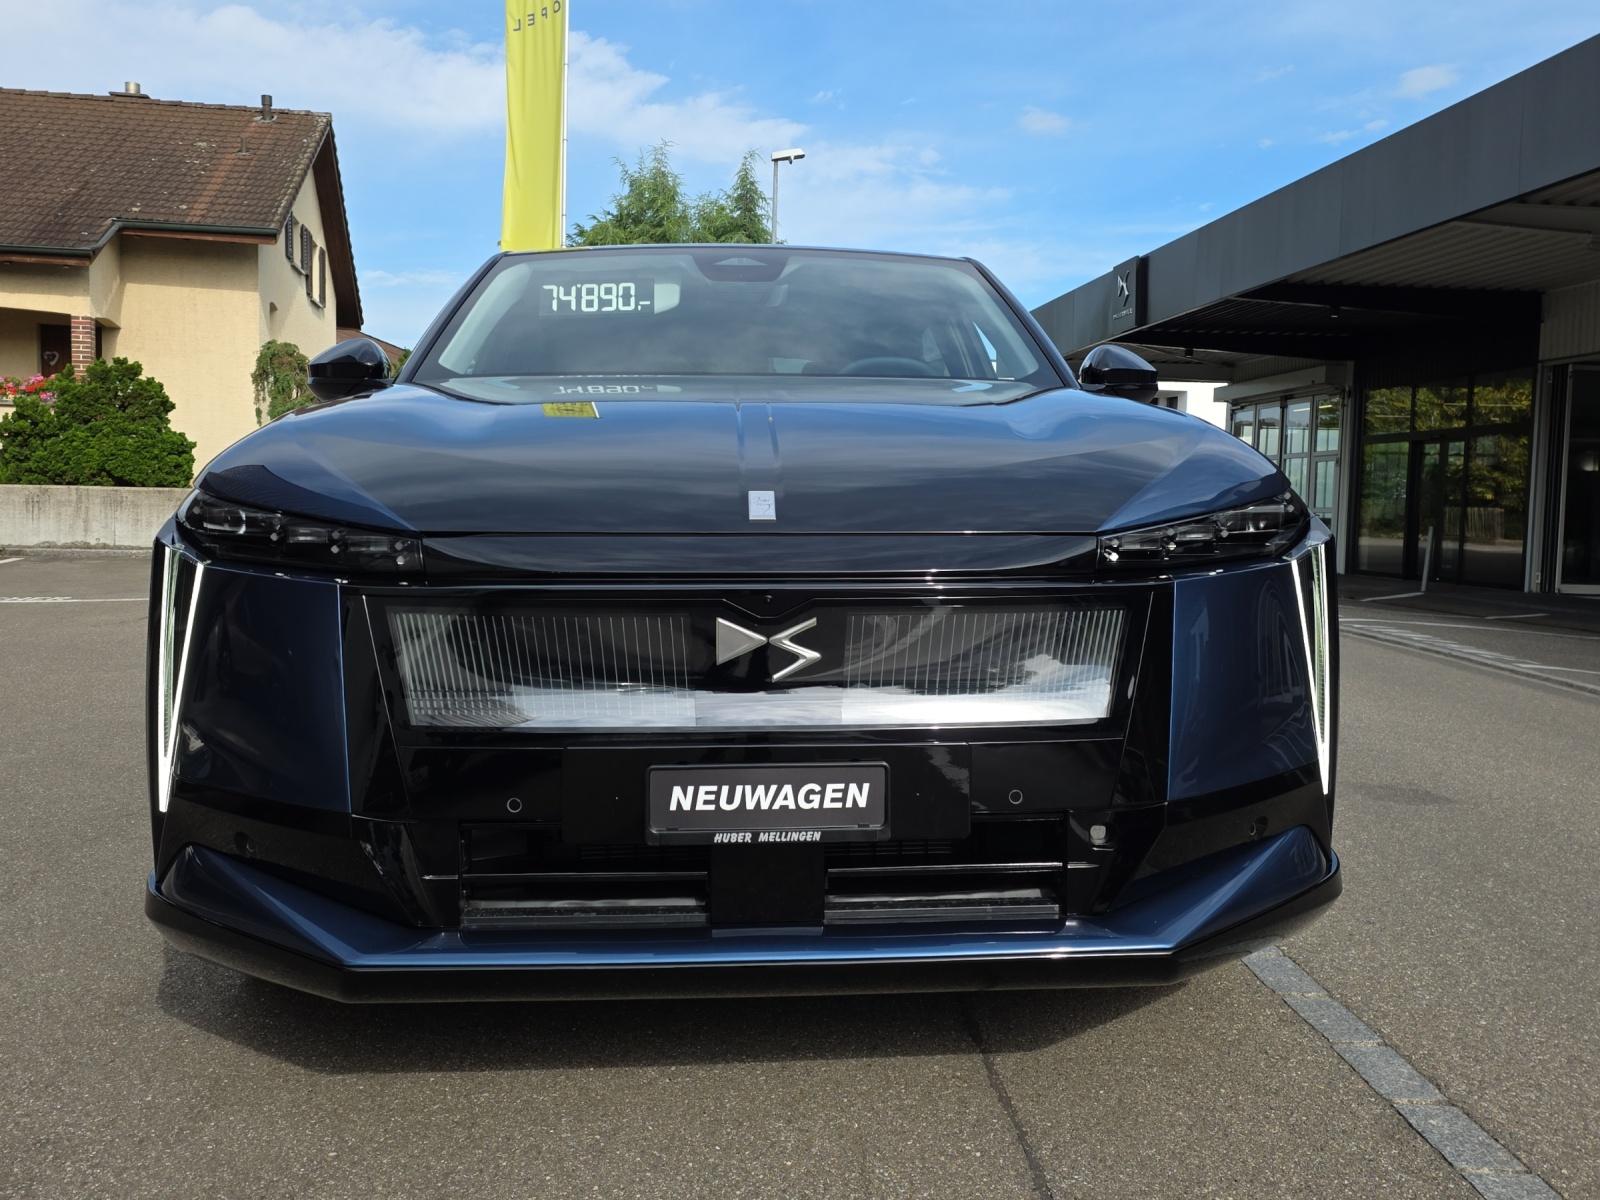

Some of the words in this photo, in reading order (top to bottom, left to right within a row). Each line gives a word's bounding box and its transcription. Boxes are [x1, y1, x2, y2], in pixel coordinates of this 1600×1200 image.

[669, 783, 870, 811] NEUWAGEN
[713, 832, 752, 843] HUBER
[758, 831, 821, 842] MELLINGEN
